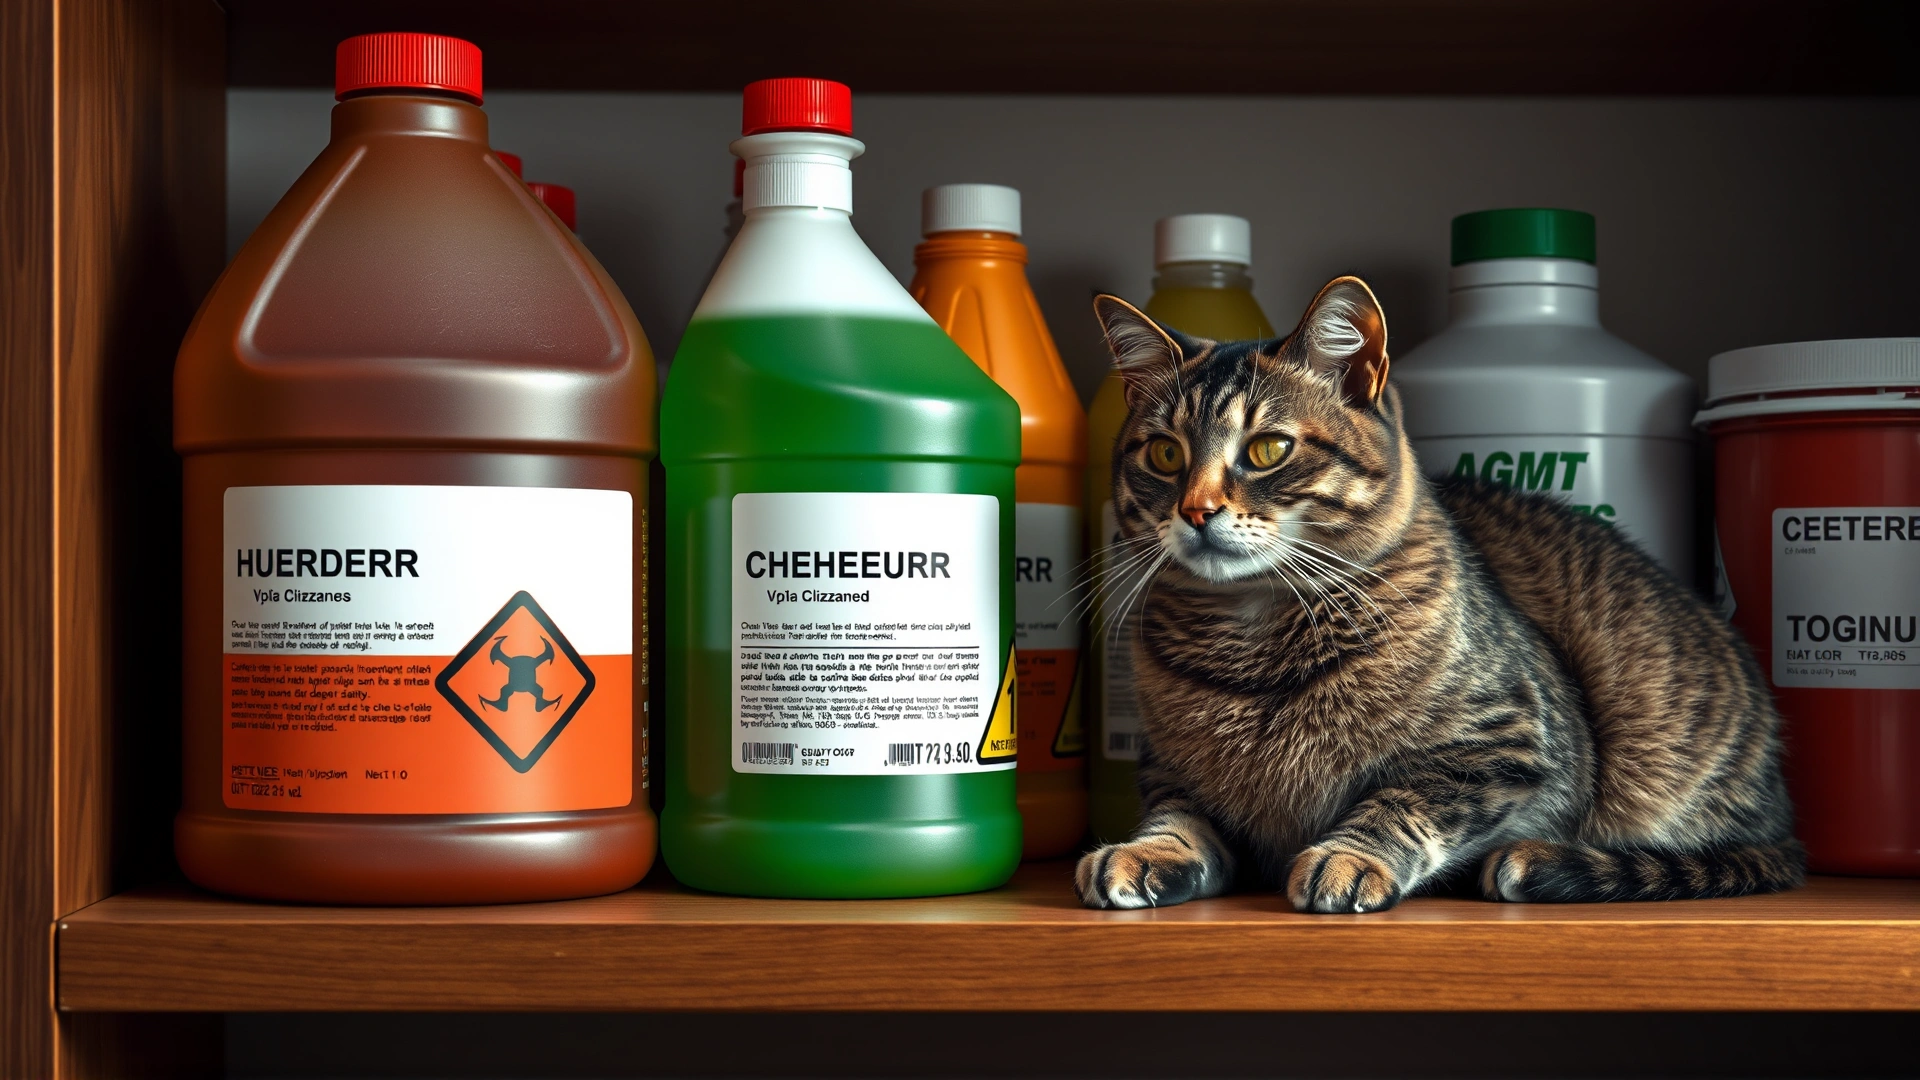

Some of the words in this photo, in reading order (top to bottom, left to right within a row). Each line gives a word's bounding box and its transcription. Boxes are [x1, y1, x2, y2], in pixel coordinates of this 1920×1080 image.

[1452, 451, 1590, 491] AGMT
[237, 549, 420, 578] HUERDERR
[745, 550, 951, 579] CHEHEEURR
[284, 588, 352, 603] Clizzanes
[802, 589, 870, 603] Clizzaned
[1786, 615, 1917, 643] TOGINU
